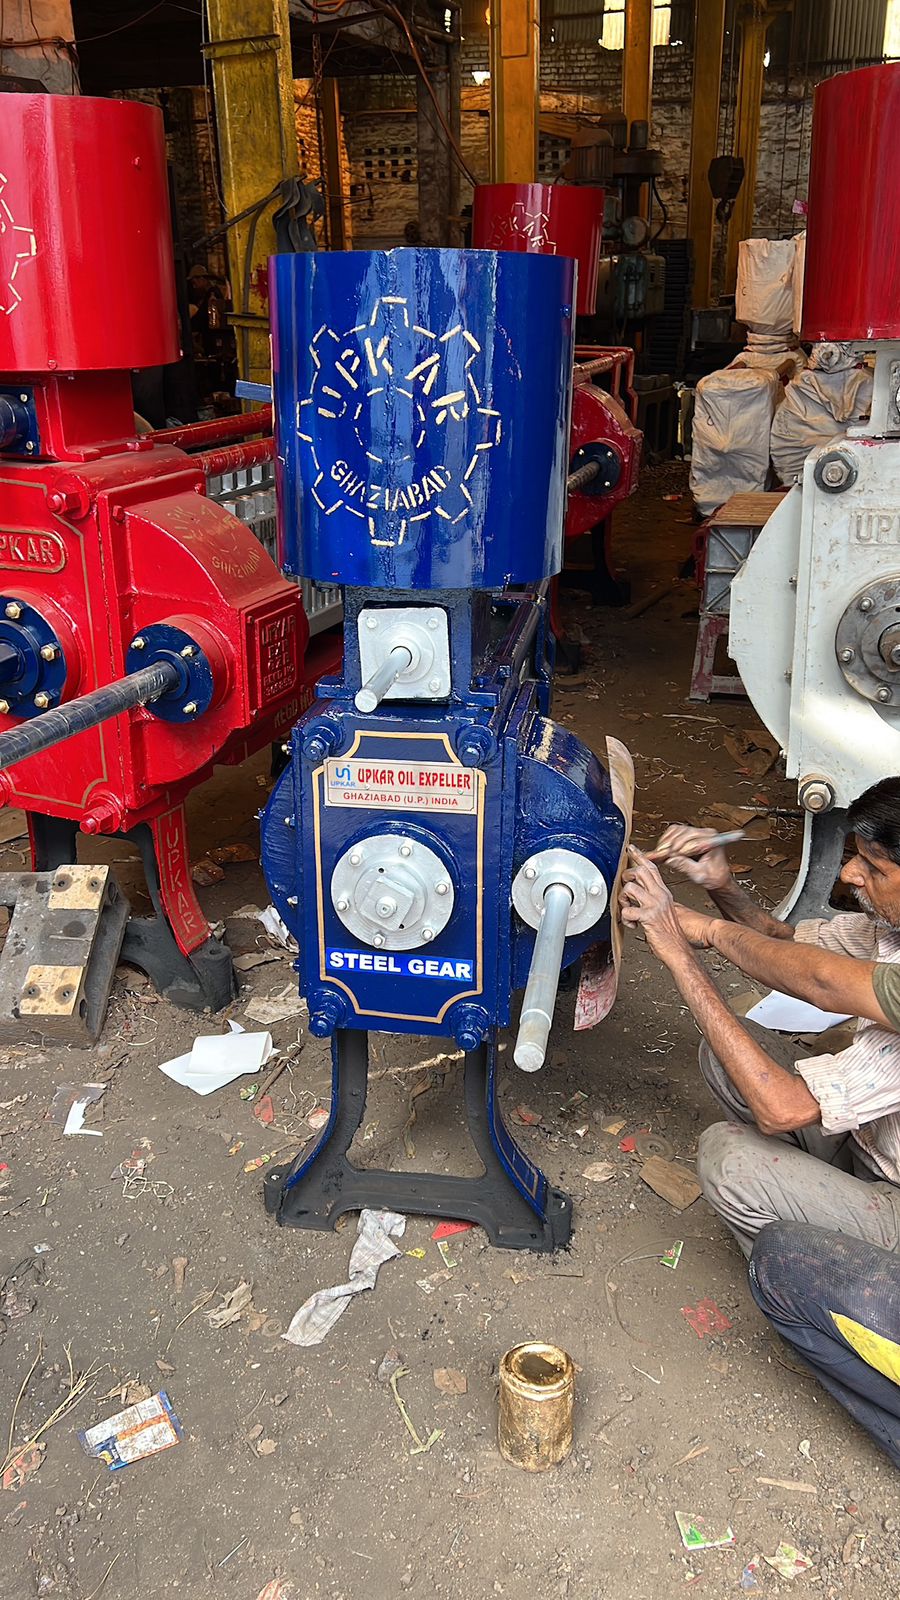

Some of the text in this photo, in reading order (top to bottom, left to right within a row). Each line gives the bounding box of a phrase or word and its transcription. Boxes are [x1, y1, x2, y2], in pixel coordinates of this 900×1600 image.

[317, 335, 469, 425] UPKAR
[330, 460, 451, 512] GHAZIABAD
[343, 792, 401, 803] GHAZIABAD
[403, 796, 429, 805] (U.P.)
[357, 768, 471, 790] UPKAR OIL EXPELLER
[166, 827, 200, 933] UPKAR
[329, 951, 471, 979] STEEL GEAR
